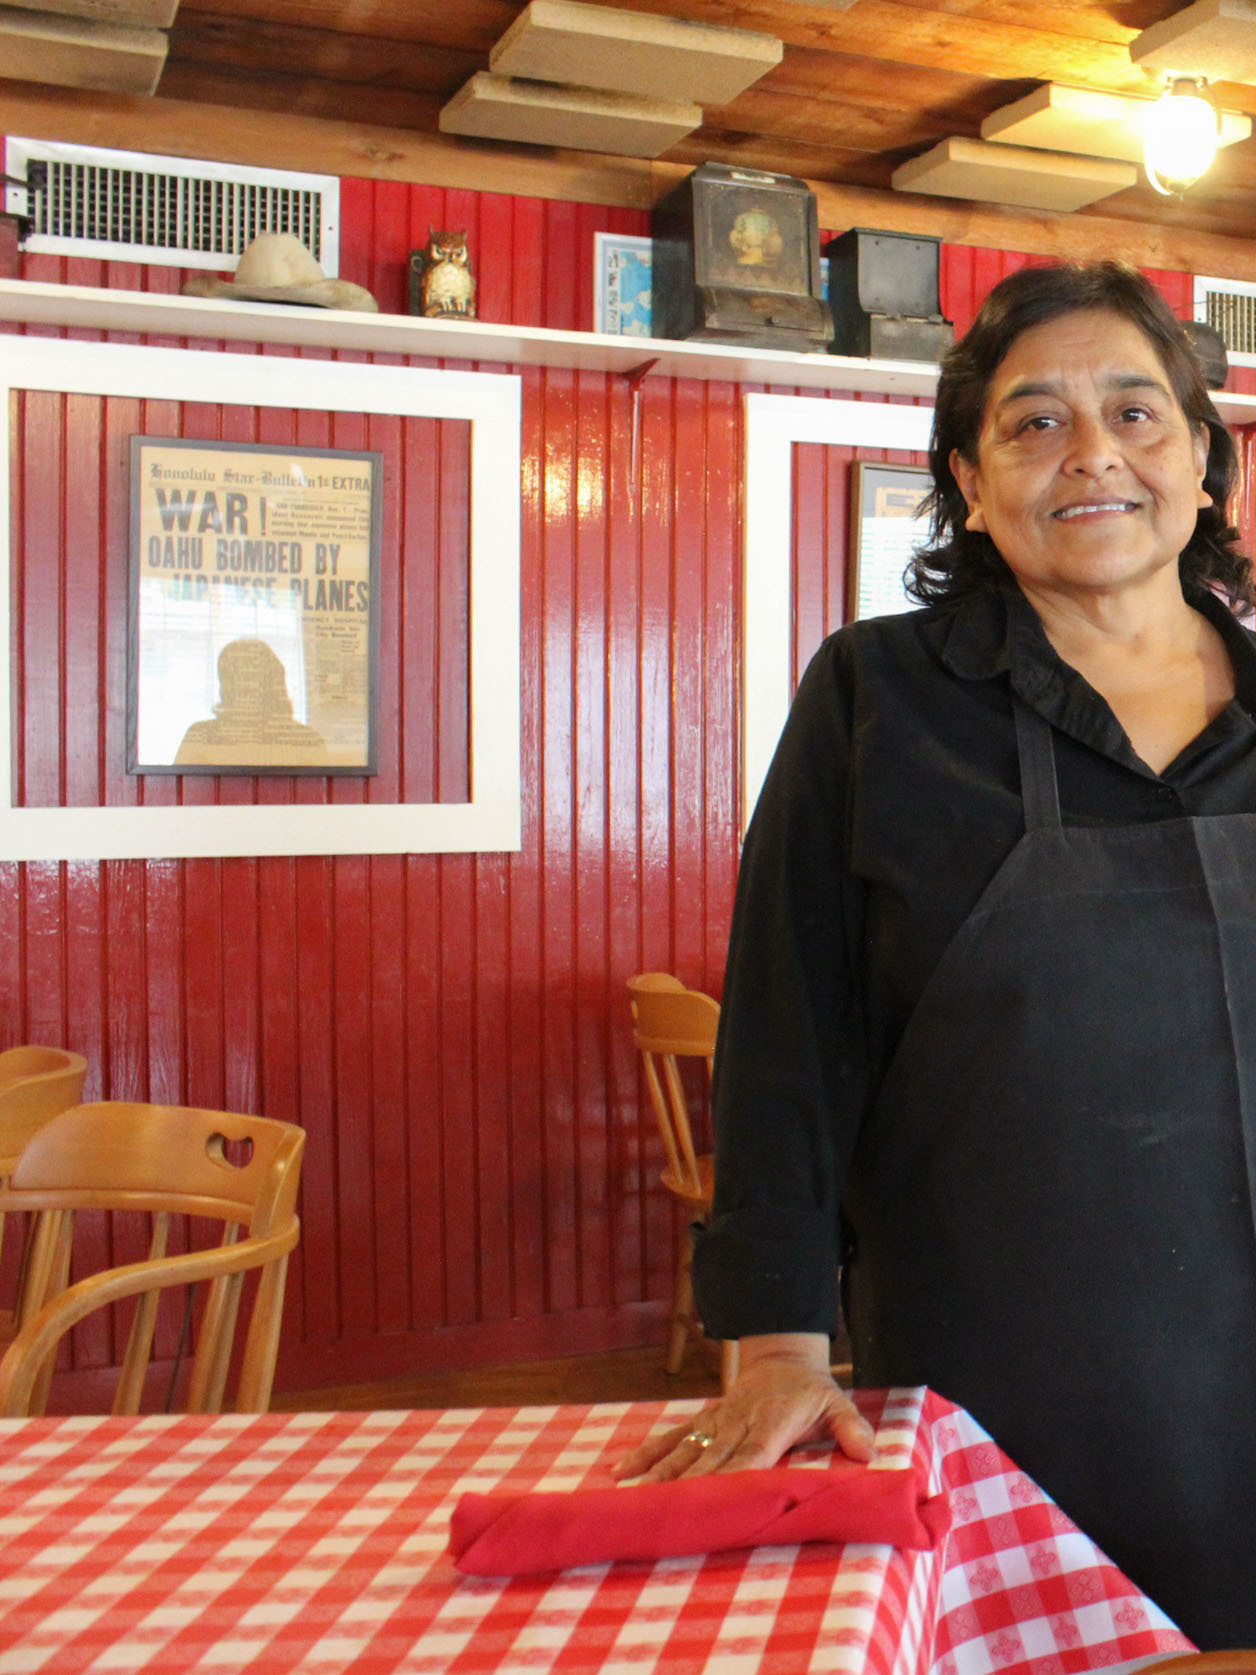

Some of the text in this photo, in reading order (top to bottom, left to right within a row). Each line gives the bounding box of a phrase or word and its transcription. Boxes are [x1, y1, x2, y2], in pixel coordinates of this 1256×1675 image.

[150, 463, 216, 482] Honolulu
[223, 468, 316, 488] Star-Bullen
[332, 476, 369, 491] EXTRA
[148, 535, 340, 575] OAHU BOMBED BY
[291, 577, 369, 612] PLANES
